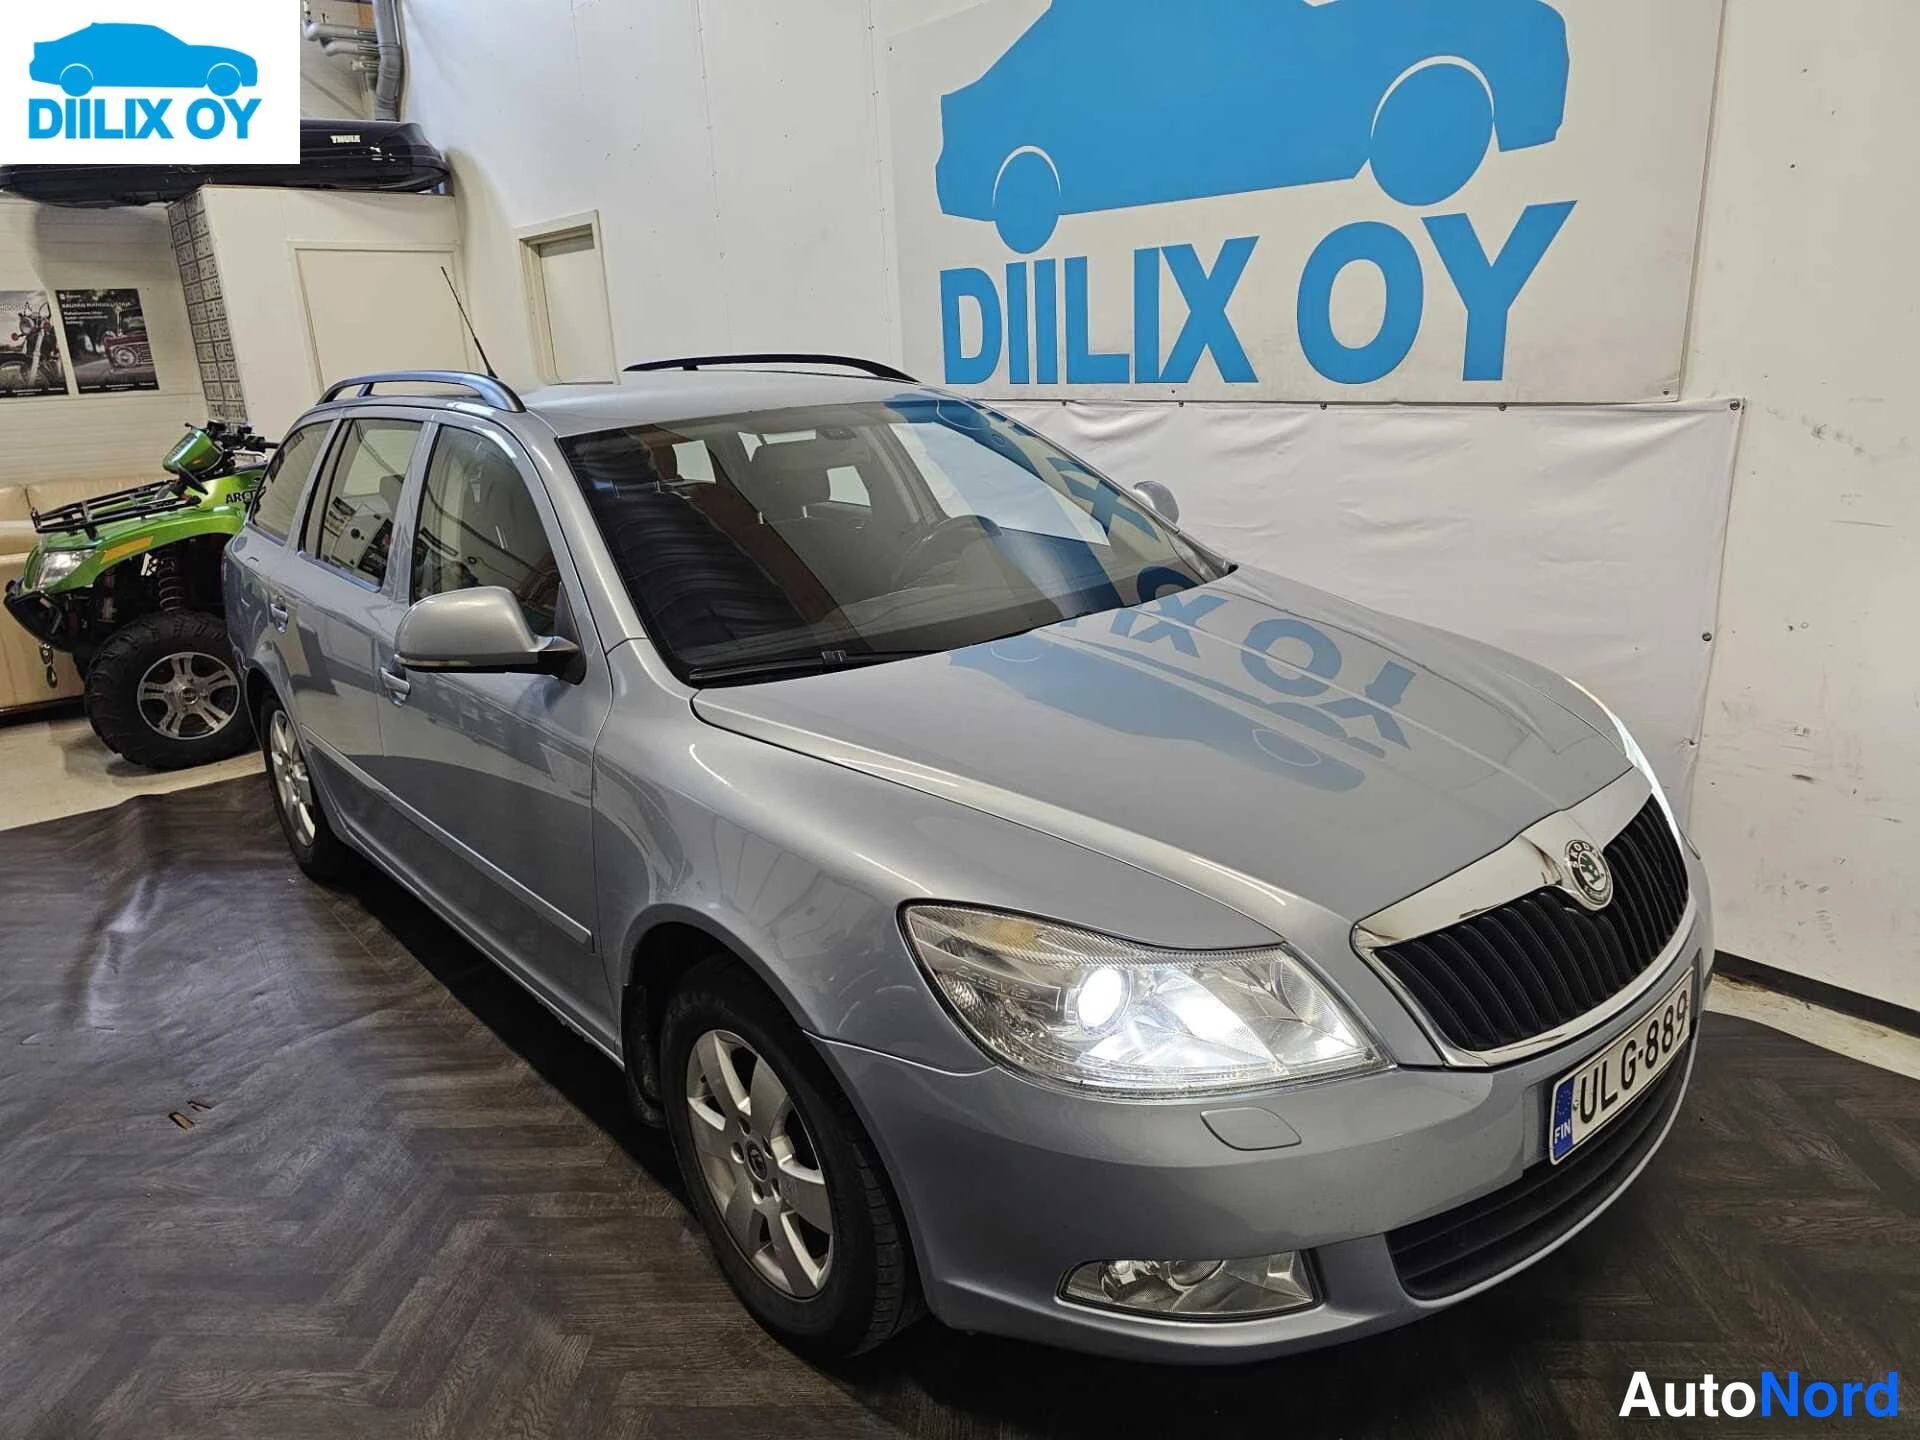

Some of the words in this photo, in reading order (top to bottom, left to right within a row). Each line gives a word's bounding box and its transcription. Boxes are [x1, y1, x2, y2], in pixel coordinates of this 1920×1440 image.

[940, 235, 1260, 385] DIILIX
[1297, 199, 1578, 385] OY
[1579, 990, 1688, 1124] ULG-889
[1554, 1120, 1572, 1144] FIN
